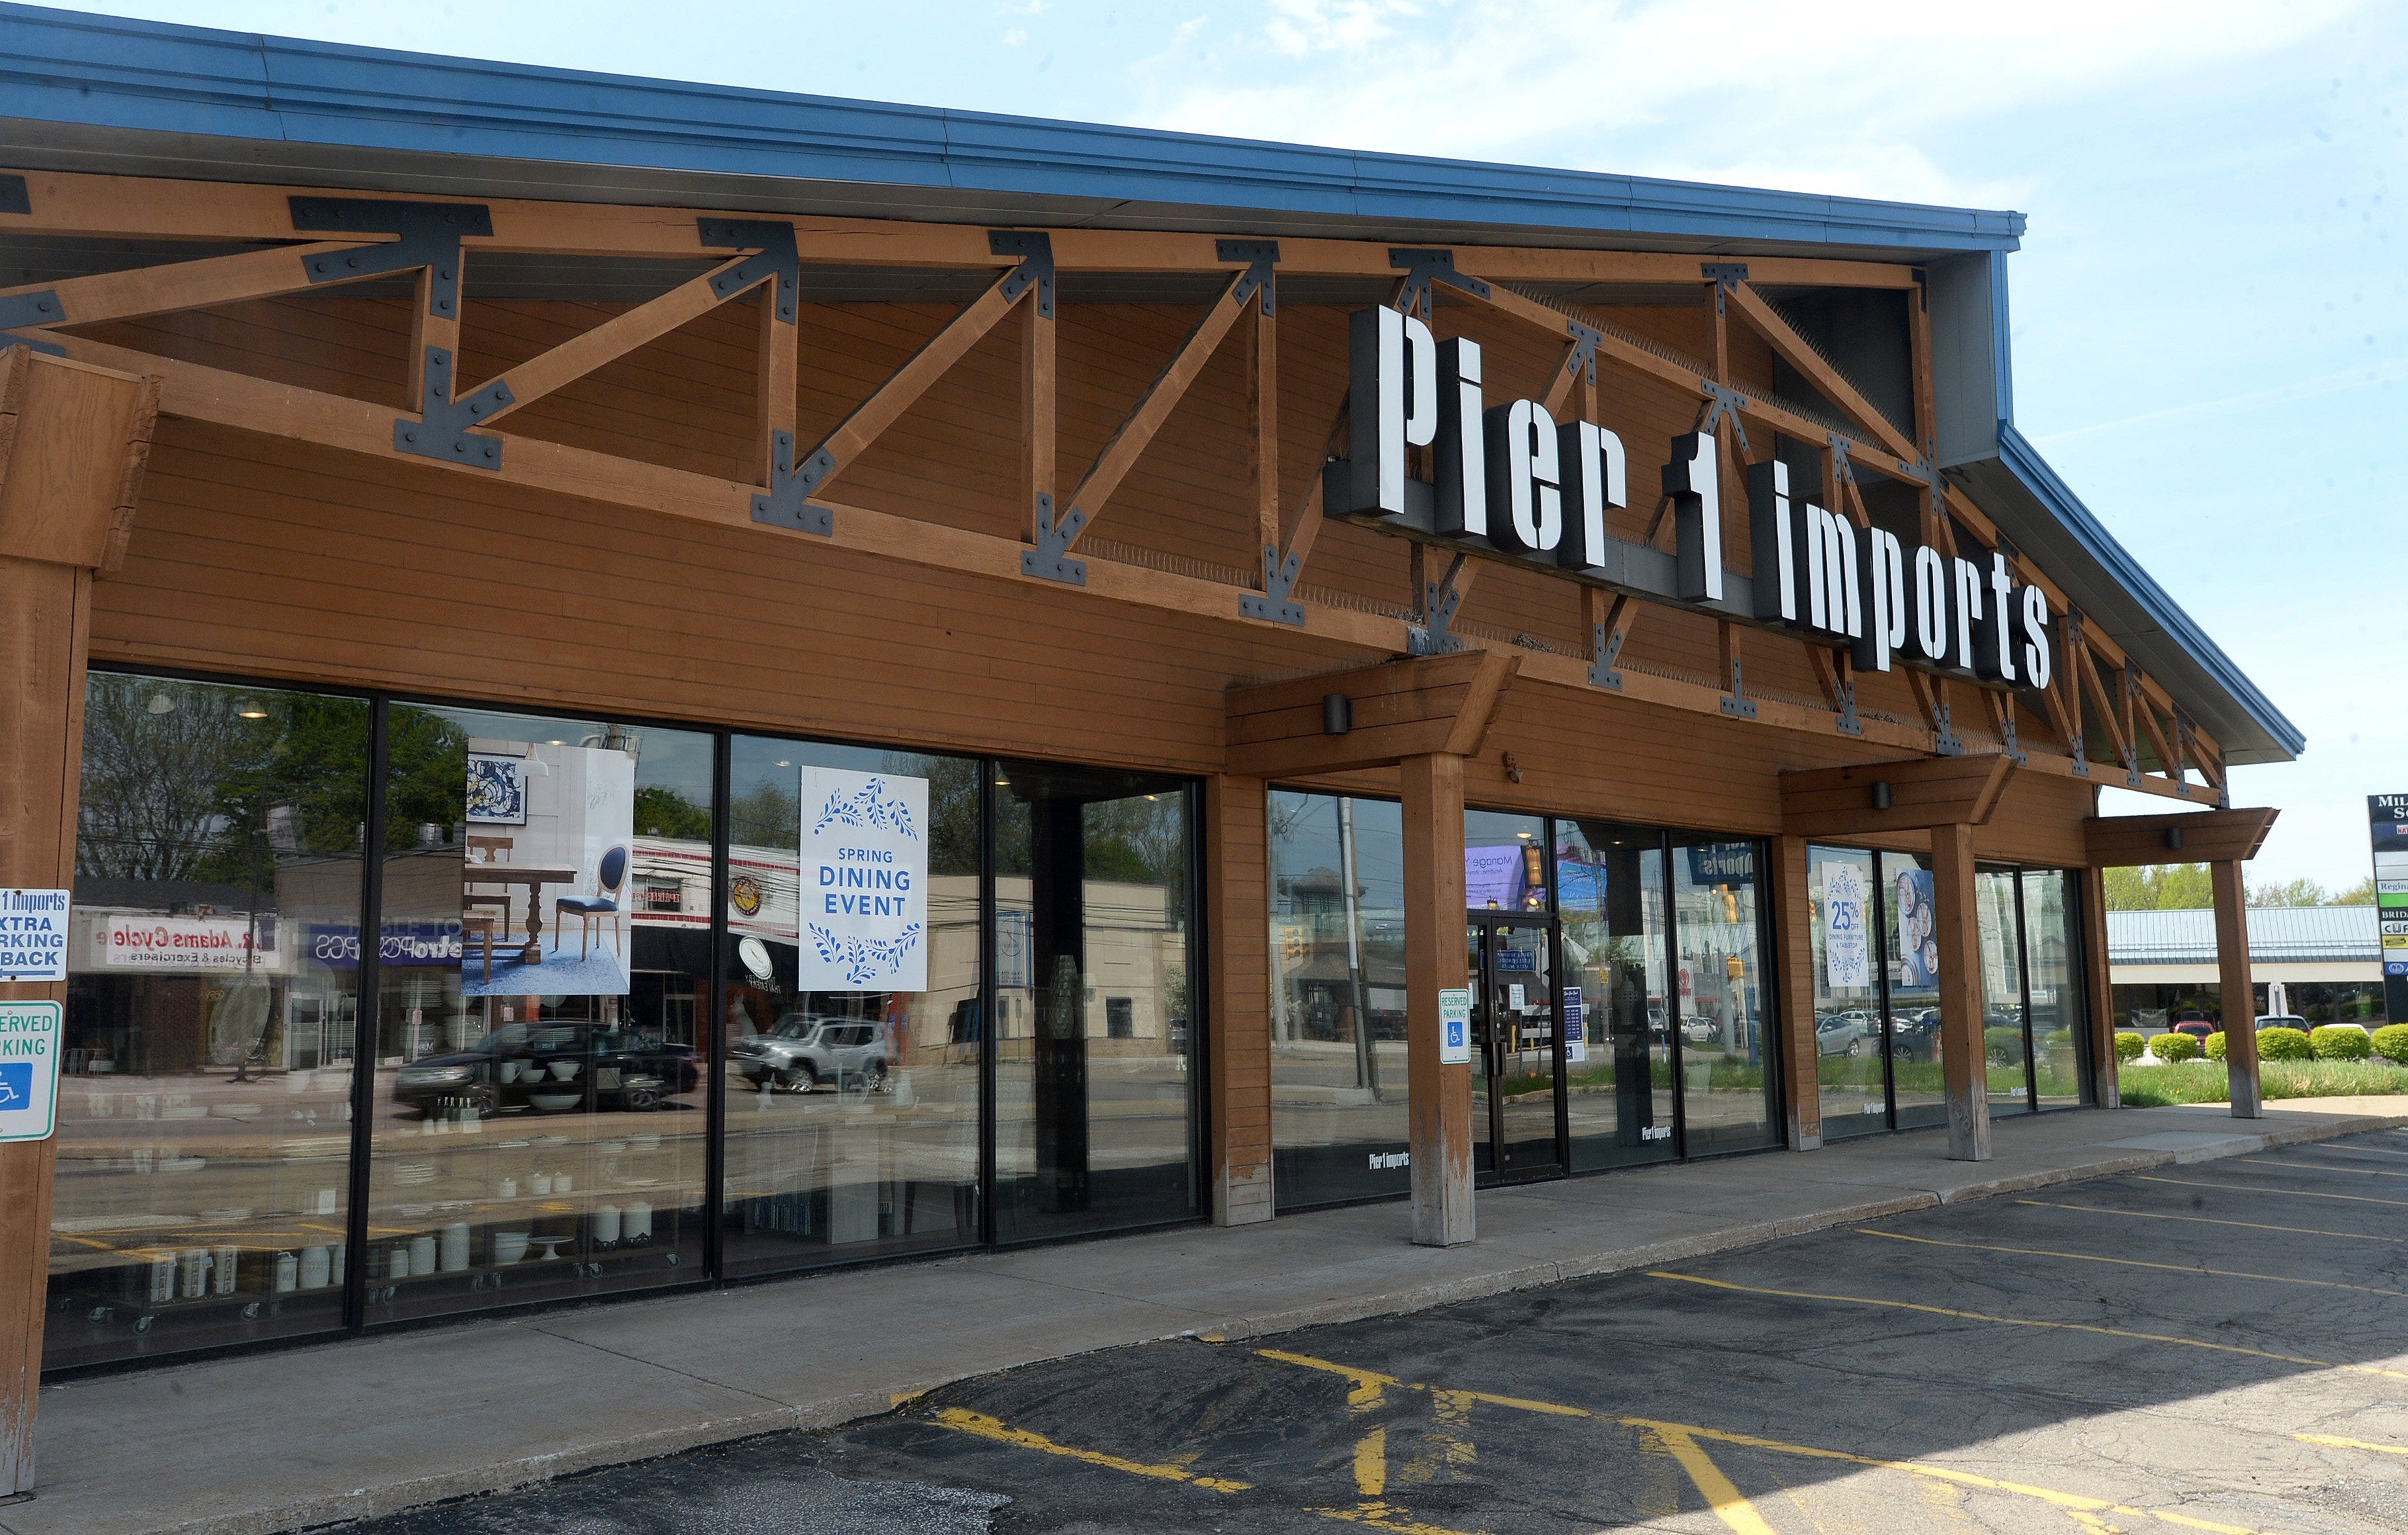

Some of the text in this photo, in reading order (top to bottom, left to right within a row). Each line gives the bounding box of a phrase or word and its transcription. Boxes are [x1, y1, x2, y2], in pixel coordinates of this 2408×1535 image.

[1376, 304, 2051, 691] Pier 1 imports
[838, 848, 893, 863] SPRING
[820, 866, 910, 891] DINING
[2, 891, 66, 913] 1 imports
[825, 893, 906, 917] EVENT
[1, 951, 59, 966] BACK
[1441, 996, 1467, 1007] RESERVED
[1443, 1009, 1466, 1019] PARKING
[1369, 1151, 1409, 1170] Pier 1 imports
